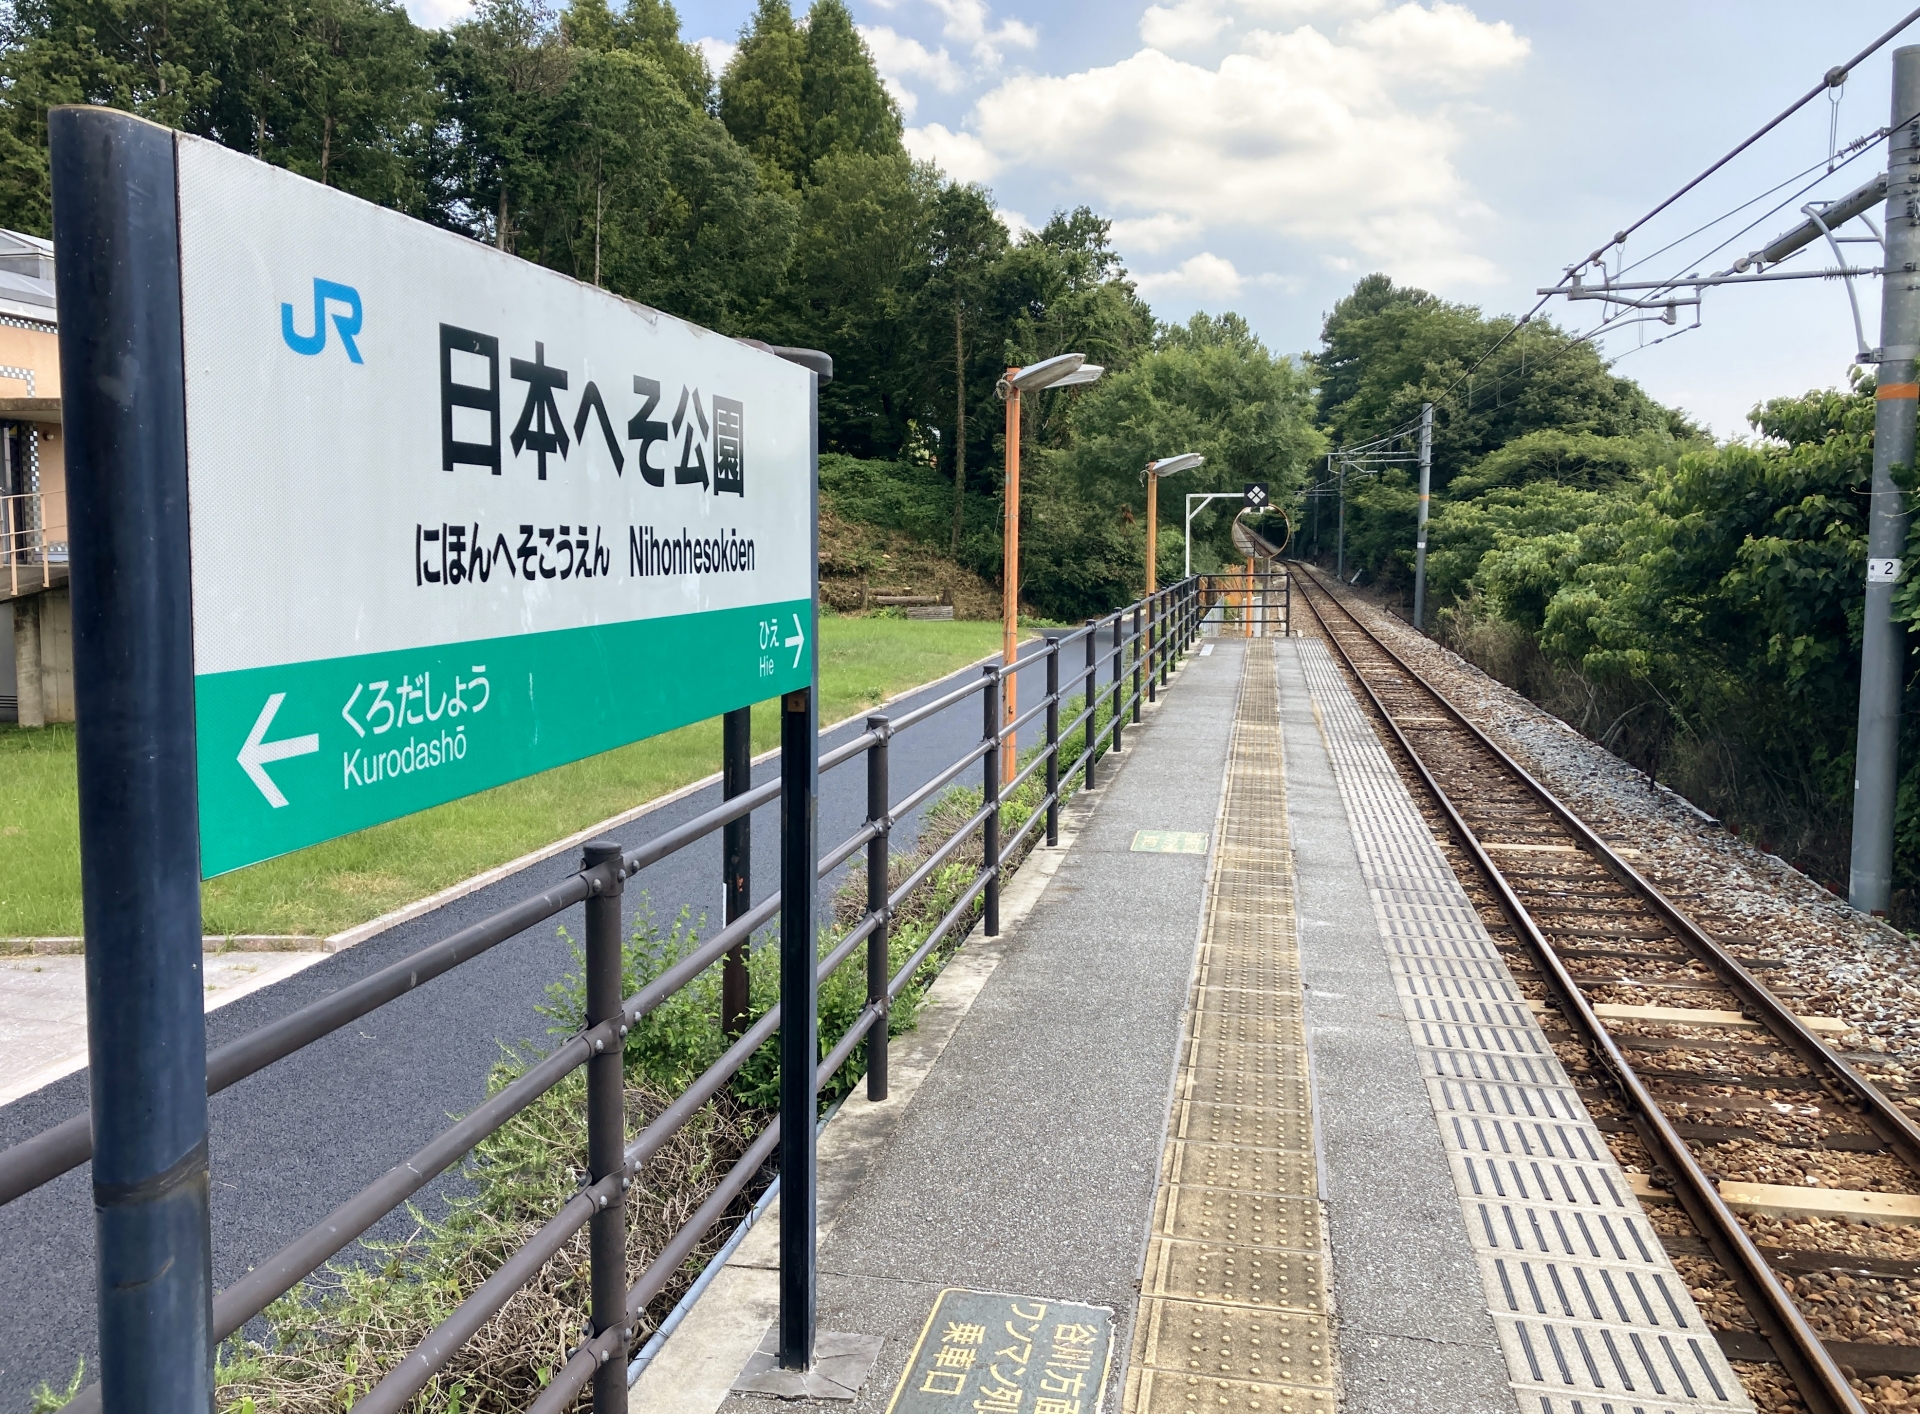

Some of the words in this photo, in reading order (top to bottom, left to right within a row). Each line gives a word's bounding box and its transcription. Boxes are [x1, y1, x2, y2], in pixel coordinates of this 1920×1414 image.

[281, 277, 364, 364] JR
[439, 322, 745, 498] 日本へそ公園
[416, 521, 611, 587] にほんへそこうえん
[629, 524, 756, 578] Nihonhesokōen
[1884, 561, 1894, 575] 2
[759, 618, 780, 650] ひえ
[759, 654, 775, 678] Hie
[341, 664, 491, 739] くろだしょう
[343, 724, 467, 790] Kurodashō
[919, 1321, 986, 1395] 乗車口
[972, 1303, 1048, 1414] ワンマン列
